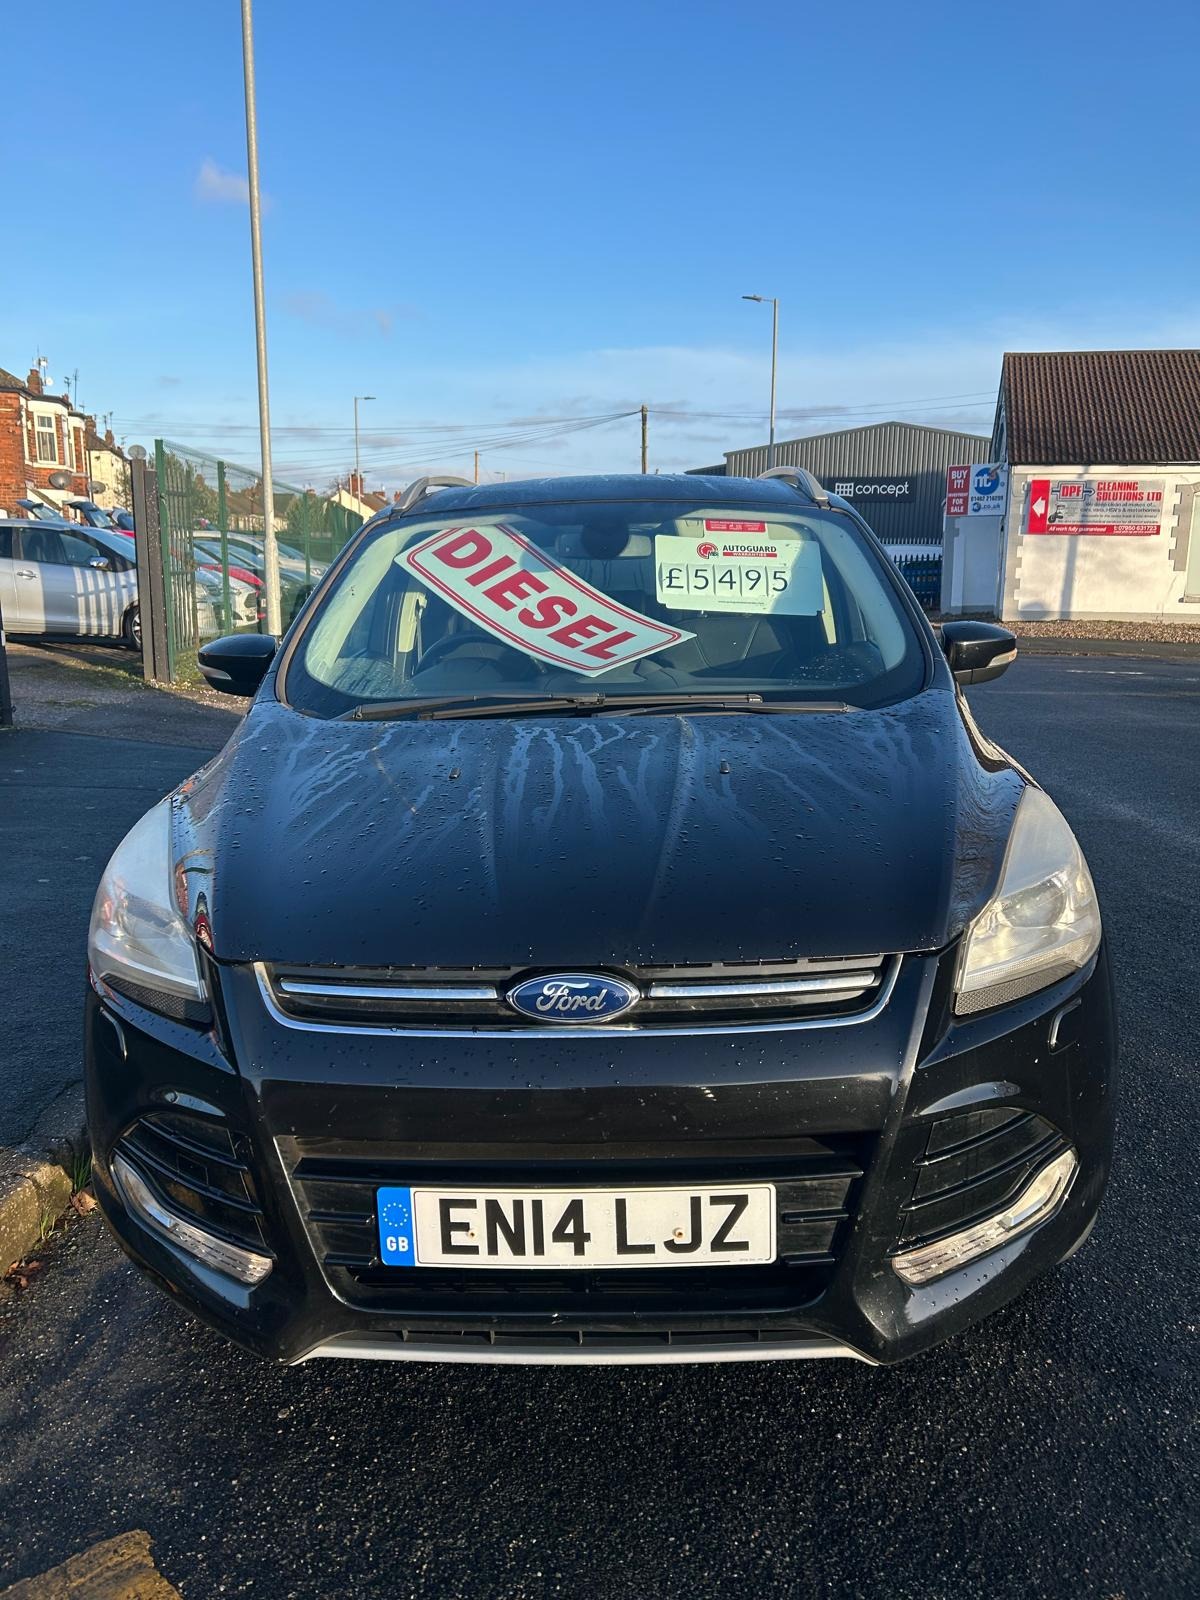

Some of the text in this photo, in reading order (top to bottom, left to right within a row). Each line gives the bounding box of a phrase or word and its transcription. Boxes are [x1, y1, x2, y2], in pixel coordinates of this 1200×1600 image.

[951, 470, 968, 479] BUY
[855, 481, 910, 498] concept
[953, 480, 964, 489] IT!
[1061, 485, 1083, 497] DPF
[1097, 481, 1139, 491] CLEANING
[1096, 491, 1163, 502] SOLUTIONS LTD
[722, 544, 777, 553] AUTOGUARD
[665, 567, 789, 593] £5495
[432, 529, 638, 660] DIESEL
[535, 981, 607, 1012] Ford
[438, 1194, 750, 1257] EN14 LJZ
[386, 1236, 409, 1252] GB
